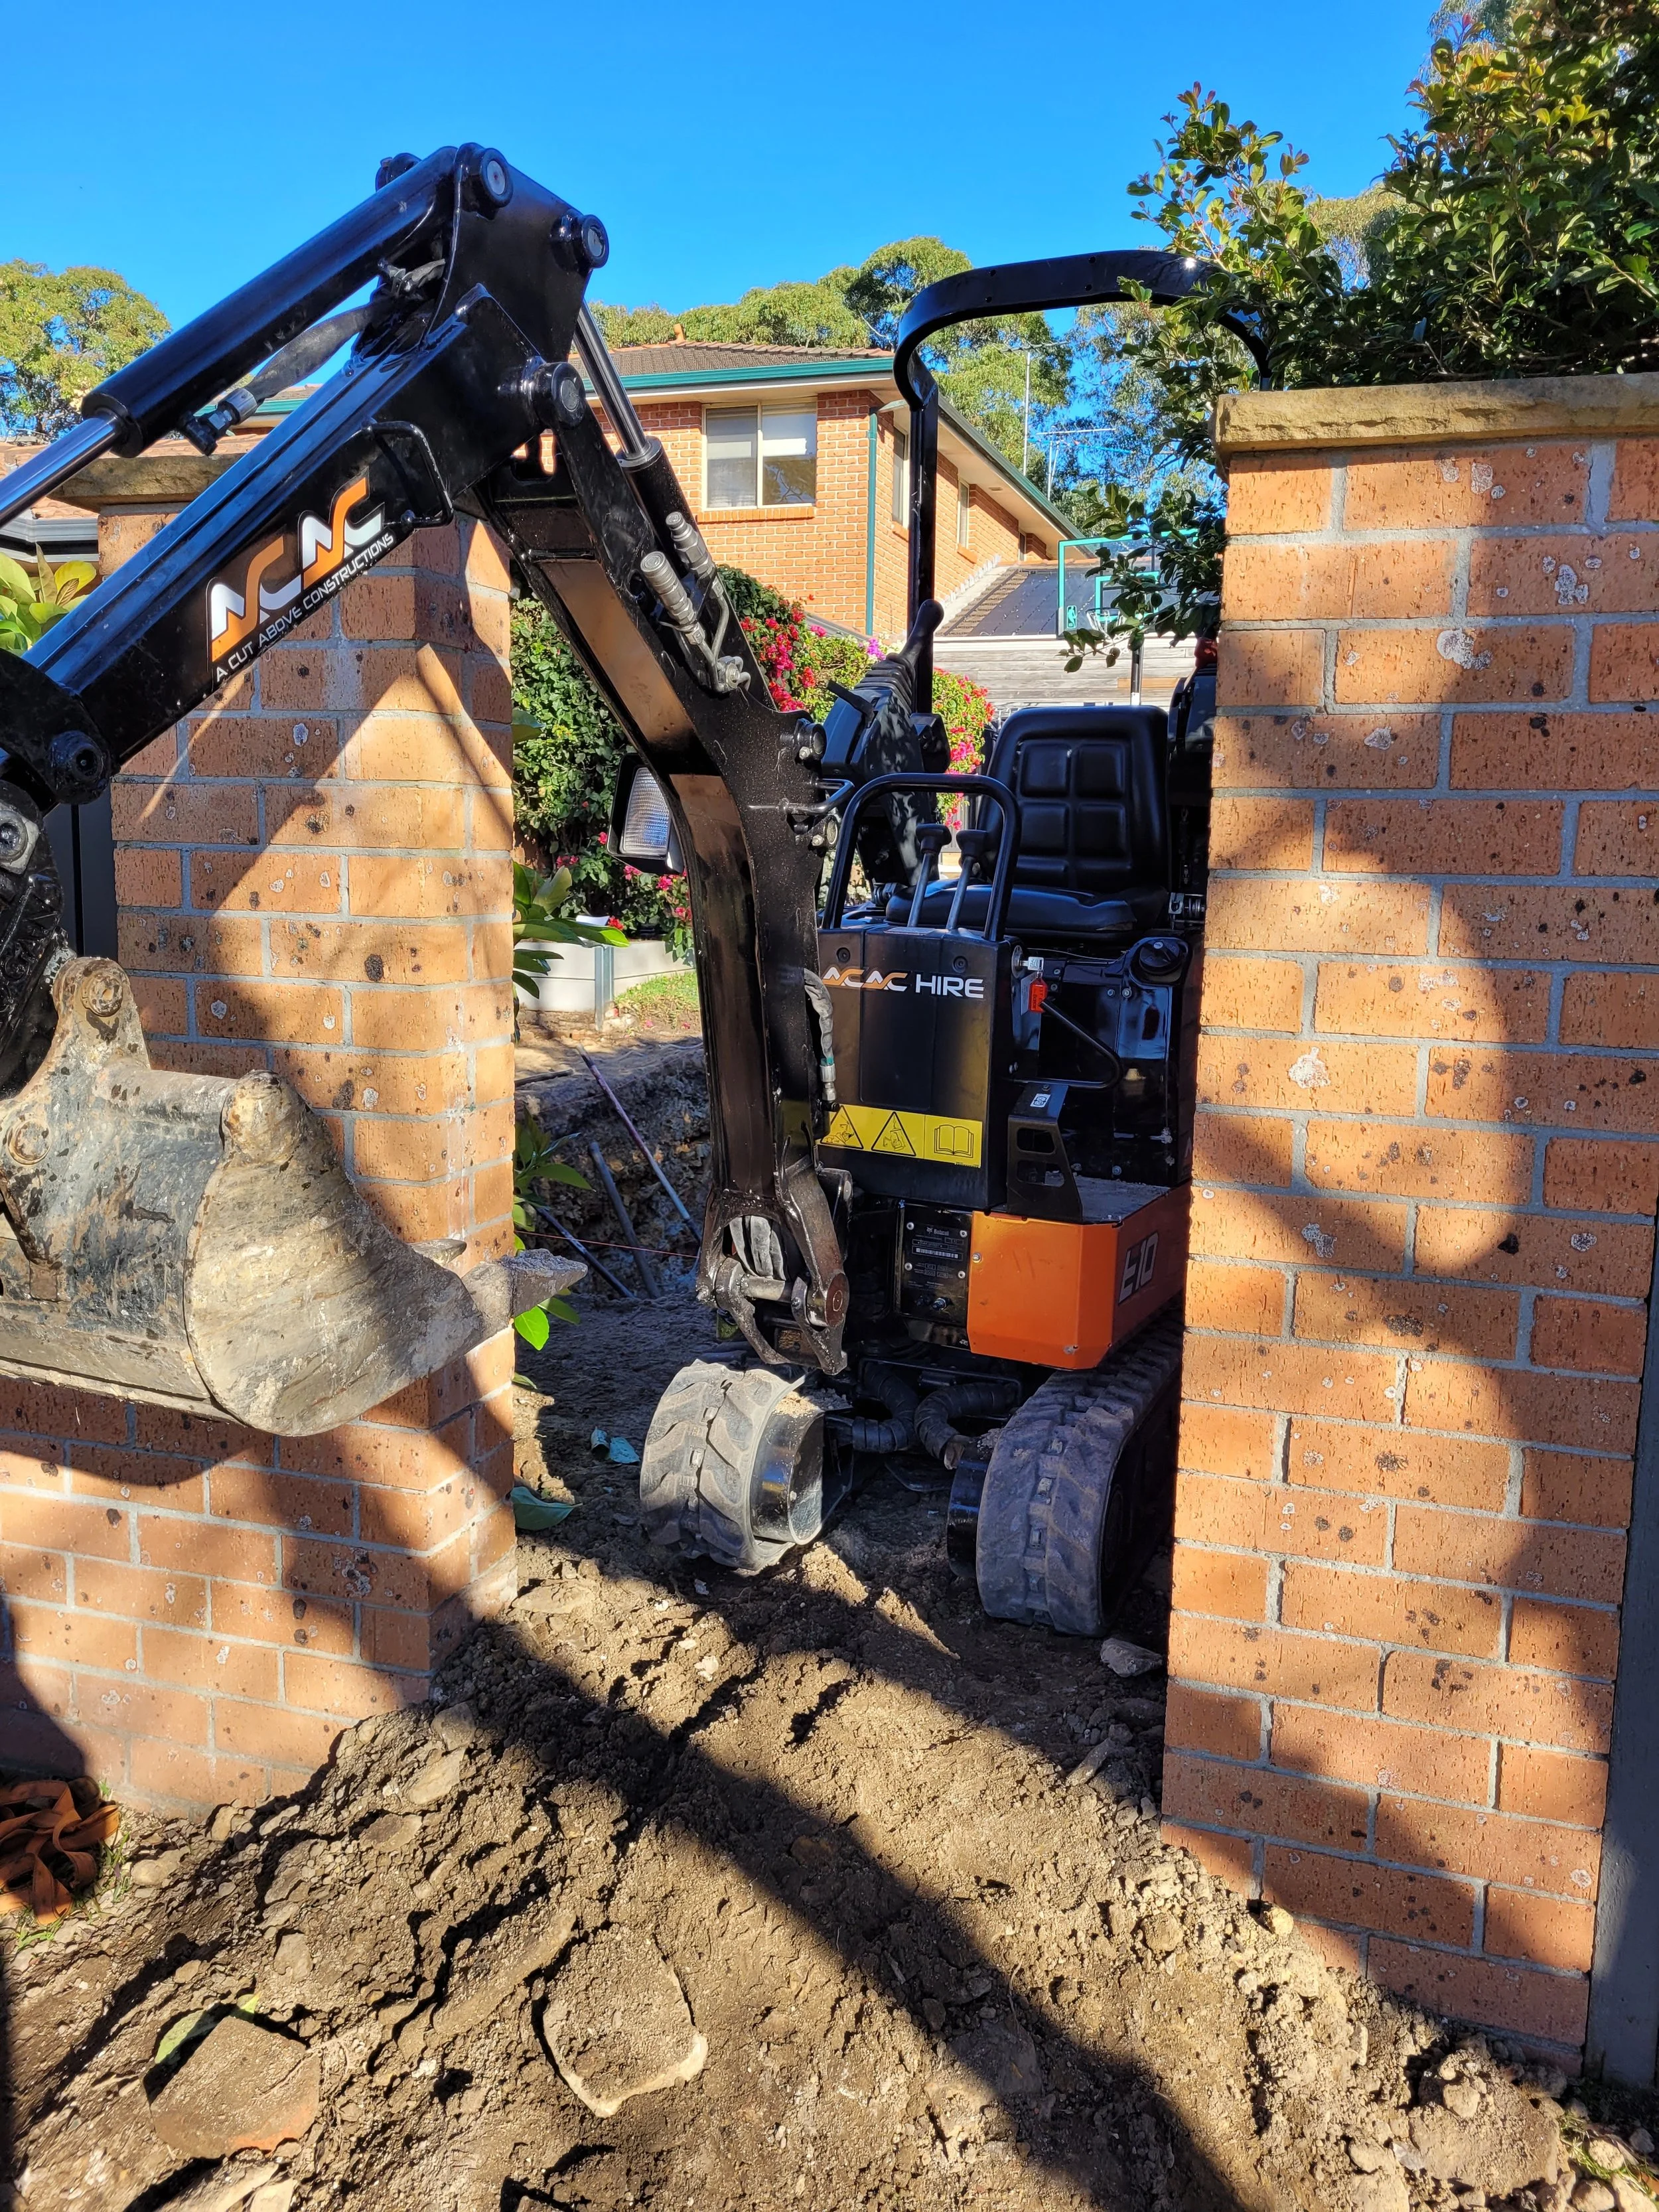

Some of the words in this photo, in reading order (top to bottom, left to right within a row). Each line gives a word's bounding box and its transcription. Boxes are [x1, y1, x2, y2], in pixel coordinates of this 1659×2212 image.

[216, 666, 228, 682] A
[228, 642, 254, 669] CUT
[257, 607, 302, 648] ABOVE
[303, 532, 394, 609] CONSTRUCTIONS
[915, 974, 985, 999] HIRE
[1118, 1232, 1159, 1303] E10
